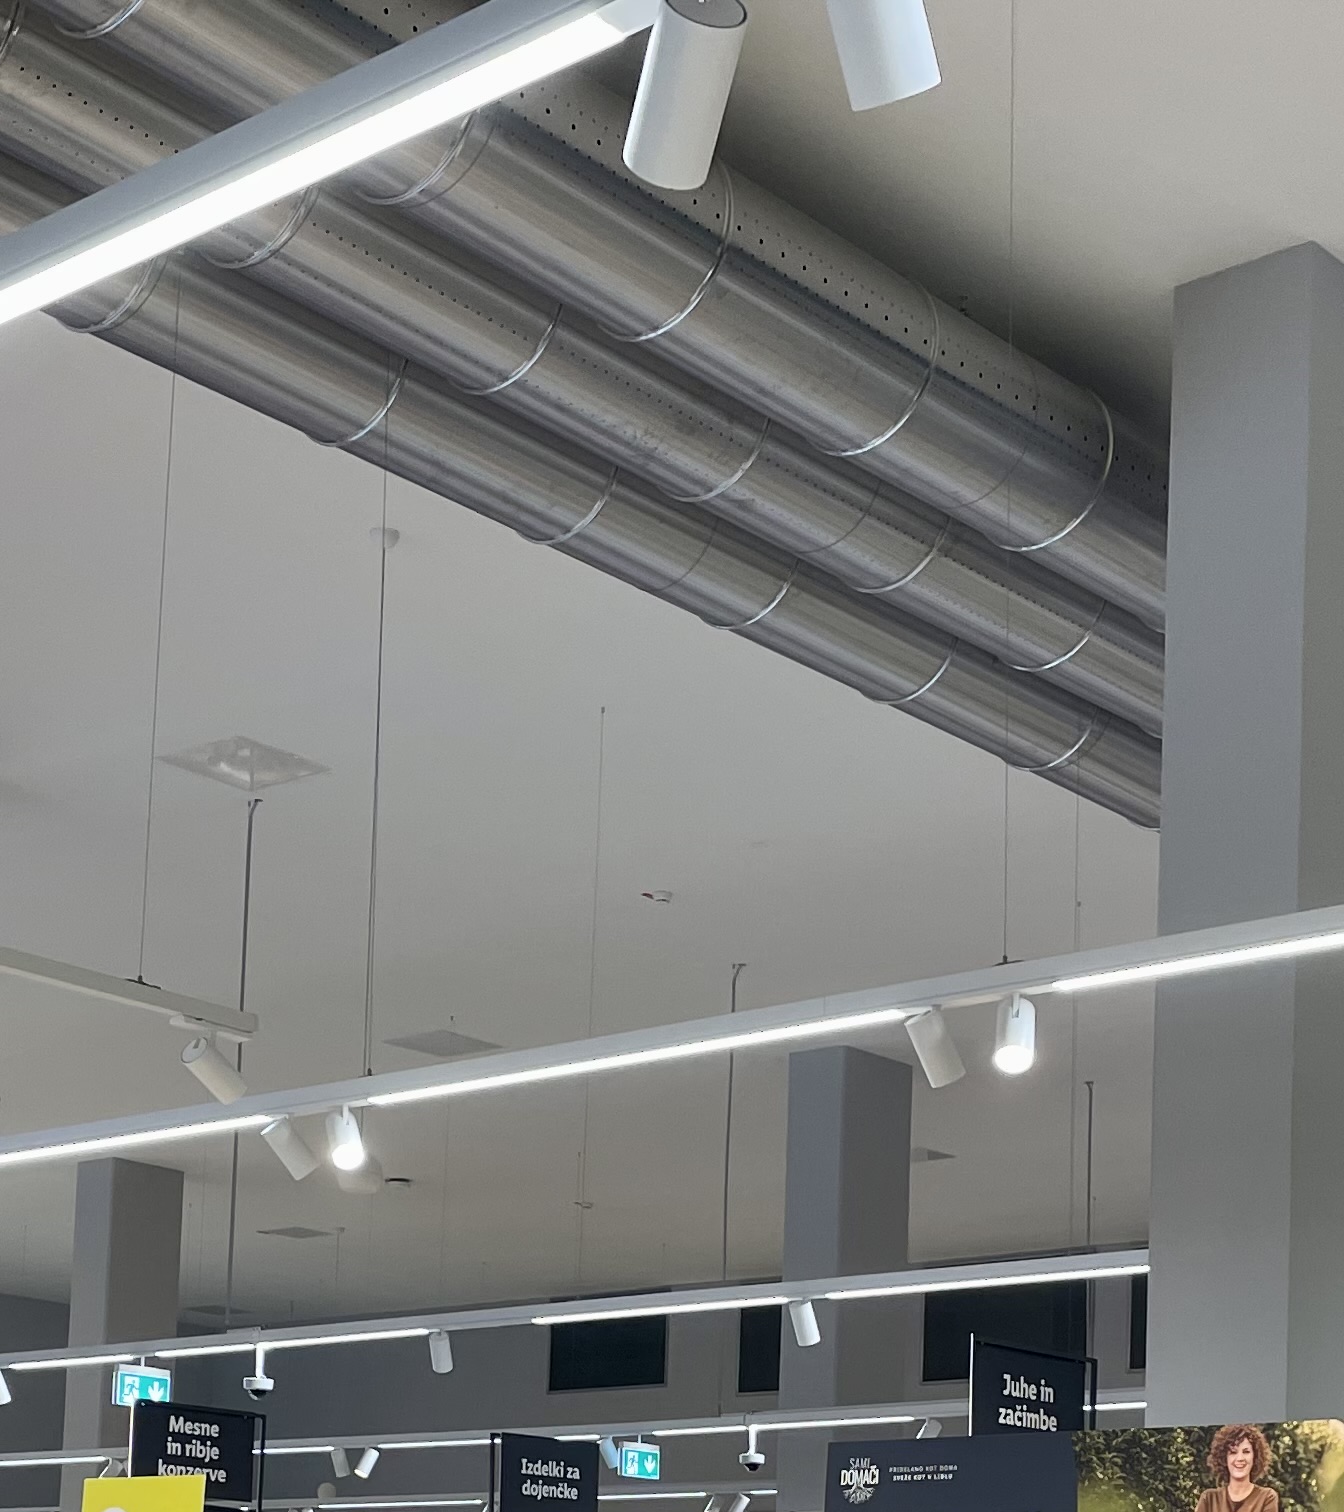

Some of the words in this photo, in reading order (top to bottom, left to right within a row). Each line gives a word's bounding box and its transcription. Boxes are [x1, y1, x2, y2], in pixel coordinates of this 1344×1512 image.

[1002, 1373, 1037, 1400] Juhe
[1040, 1381, 1054, 1403] in
[169, 1415, 220, 1438] Mesne
[998, 1404, 1058, 1432] začimbe
[166, 1436, 182, 1456] in
[185, 1439, 220, 1462] ribje
[520, 1457, 565, 1479] Izdelki
[567, 1465, 580, 1480] za
[840, 1465, 880, 1486] DOMAČI
[521, 1478, 578, 1501] dojenčke
